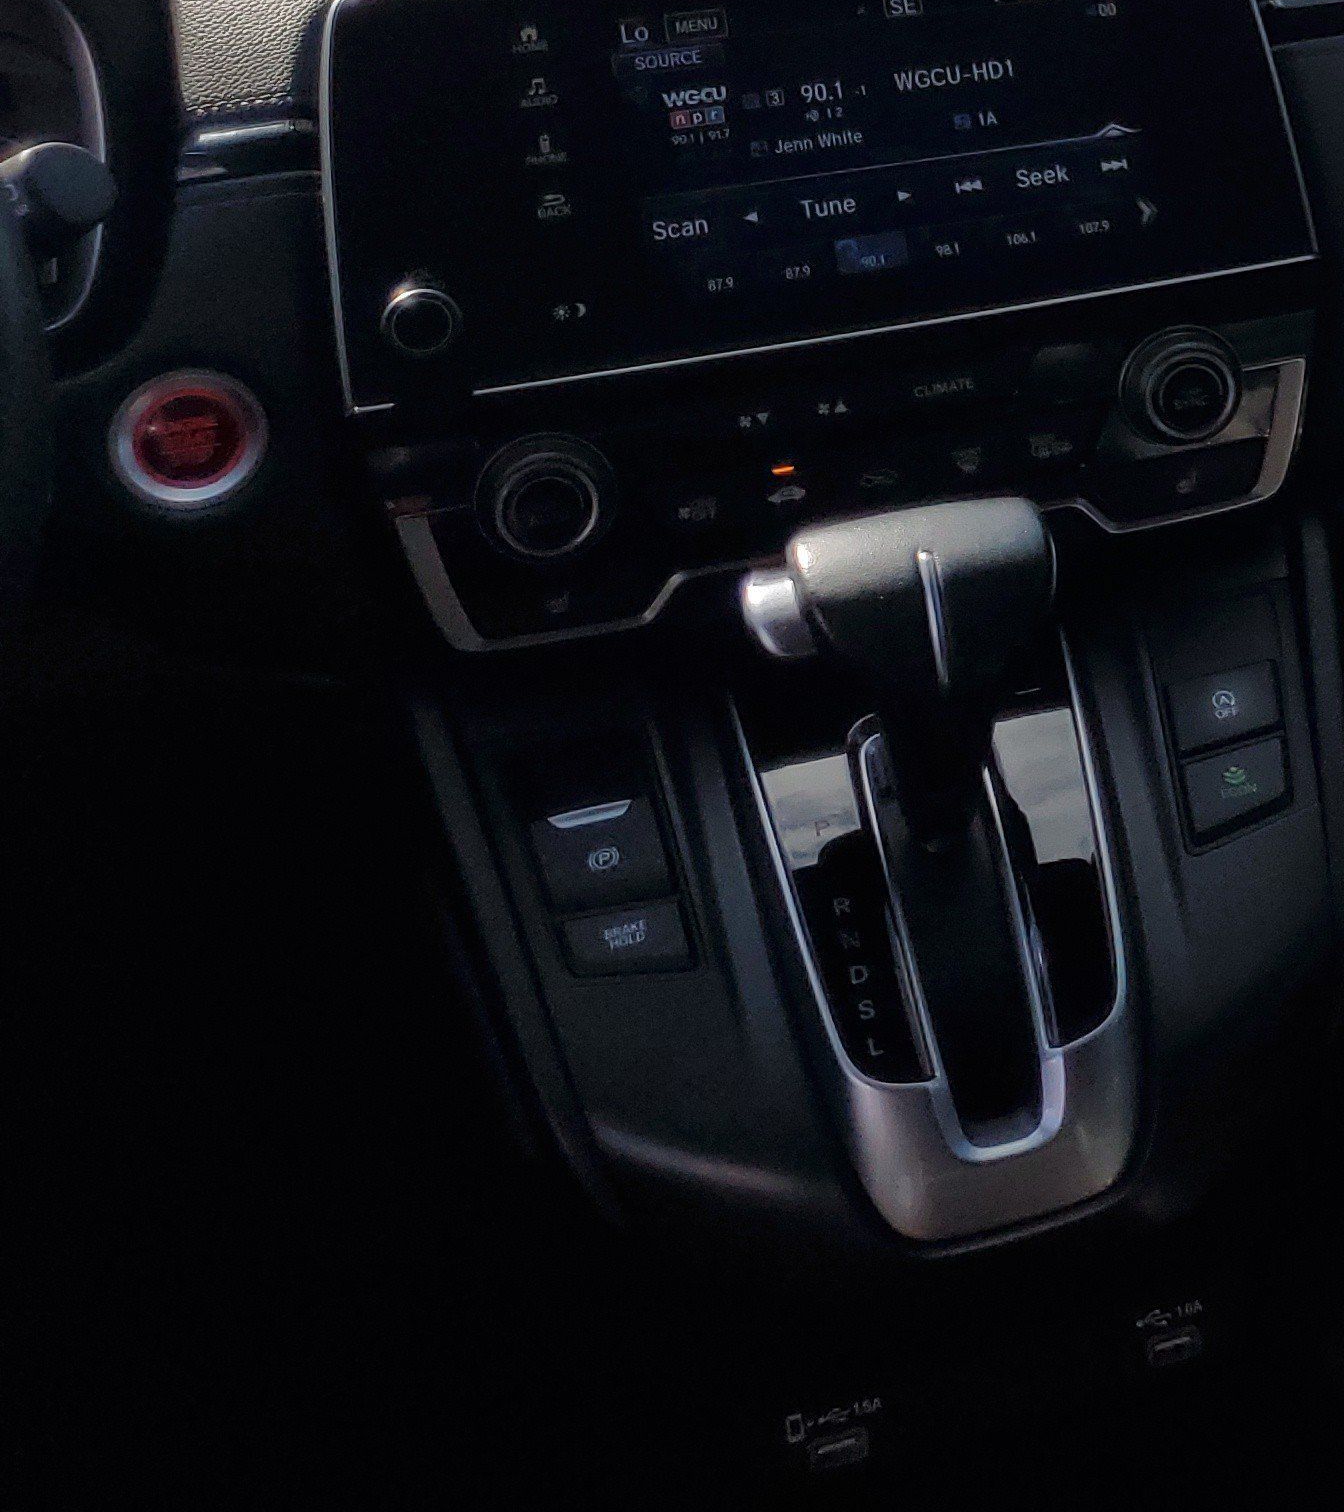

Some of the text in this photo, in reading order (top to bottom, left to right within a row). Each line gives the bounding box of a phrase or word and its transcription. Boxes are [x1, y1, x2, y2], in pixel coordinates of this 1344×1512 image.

[619, 24, 650, 45] Lo
[675, 16, 718, 34] MENU
[634, 49, 704, 71] SOURCE
[893, 58, 1015, 91] WGCU-HD1
[661, 85, 728, 109] WGCU
[800, 80, 844, 104] 90.1
[774, 137, 814, 155] Jenn
[817, 129, 864, 150] White
[1015, 164, 1070, 189] Seek
[800, 197, 857, 220] Tune
[652, 217, 709, 241] Scan
[912, 376, 975, 398] CLIMATE
[850, 965, 869, 985] D
[858, 999, 876, 1020] S
[866, 1037, 885, 1057] L
